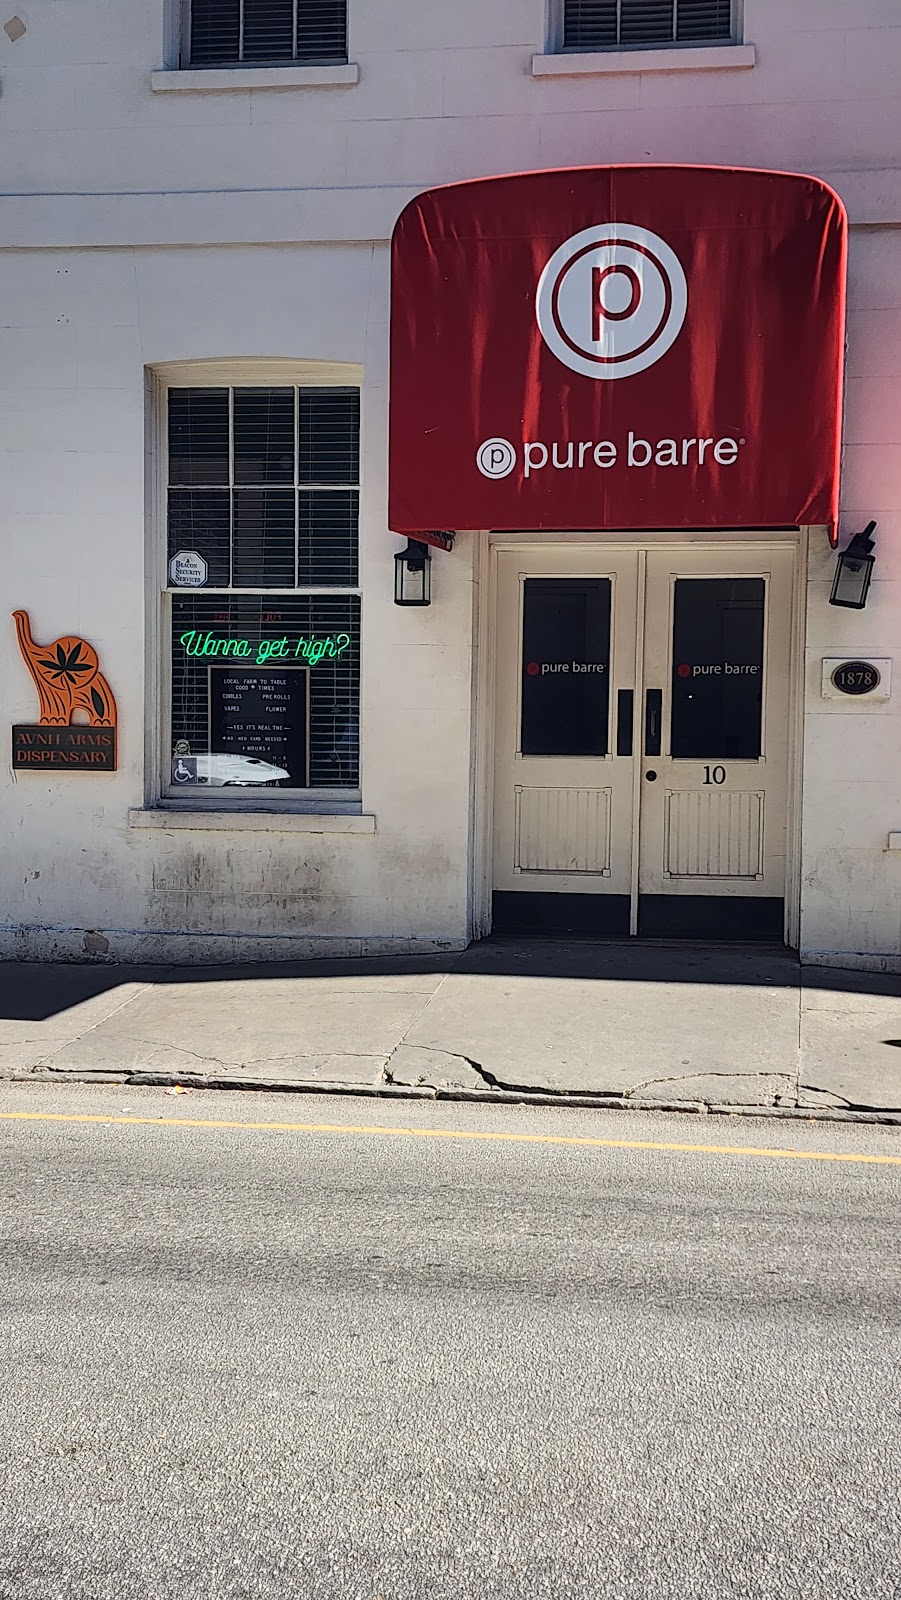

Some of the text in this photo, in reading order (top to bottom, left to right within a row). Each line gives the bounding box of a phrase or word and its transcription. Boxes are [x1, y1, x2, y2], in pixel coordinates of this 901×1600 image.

[591, 264, 642, 342] p
[523, 441, 617, 478] pure
[180, 630, 350, 665] Wanna get high?
[541, 662, 570, 675] pure
[692, 665, 722, 677] pure
[840, 672, 873, 685] 1878
[16, 733, 112, 746] AVNI FARMS
[16, 750, 109, 763] DISPENSARY
[702, 766, 726, 785] 10
